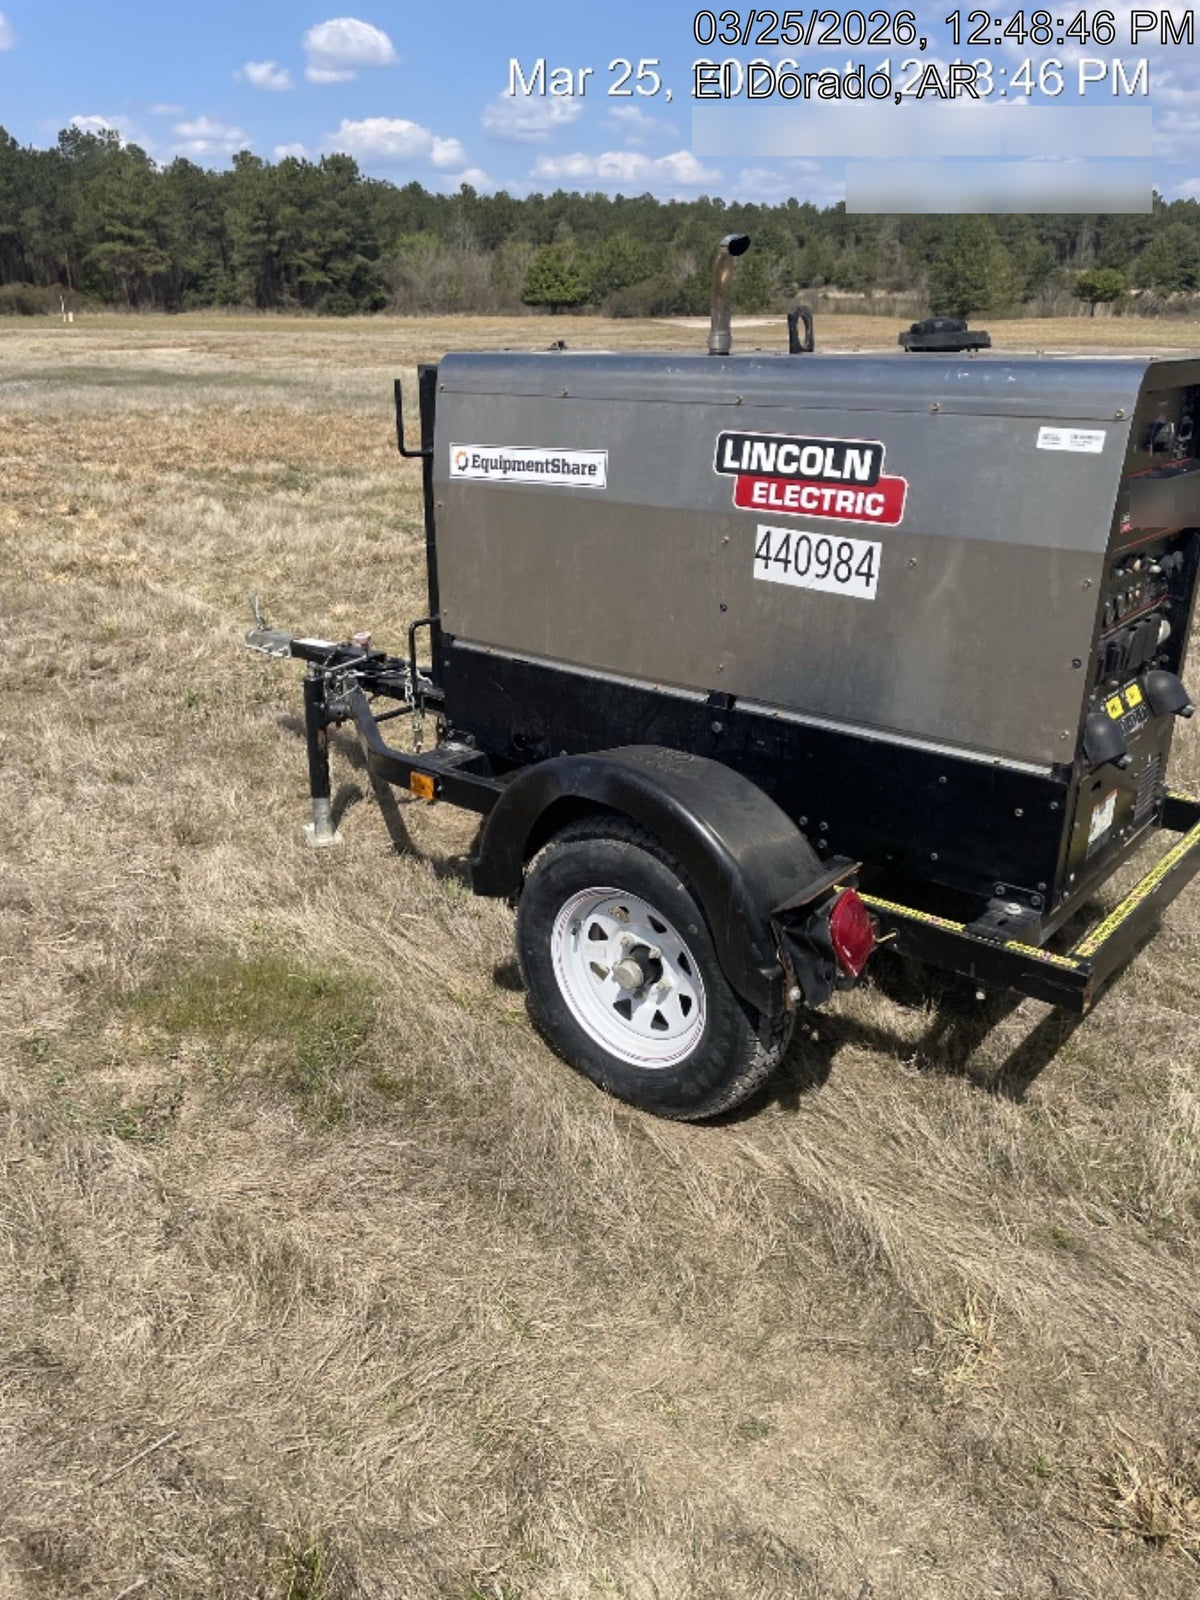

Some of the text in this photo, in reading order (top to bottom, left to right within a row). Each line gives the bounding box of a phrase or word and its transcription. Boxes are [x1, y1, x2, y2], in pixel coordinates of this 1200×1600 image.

[471, 454, 598, 476] EquipmentShare
[723, 438, 873, 481] LINCOLN
[752, 481, 885, 516] ELECTRIC
[755, 530, 875, 587] 440984
